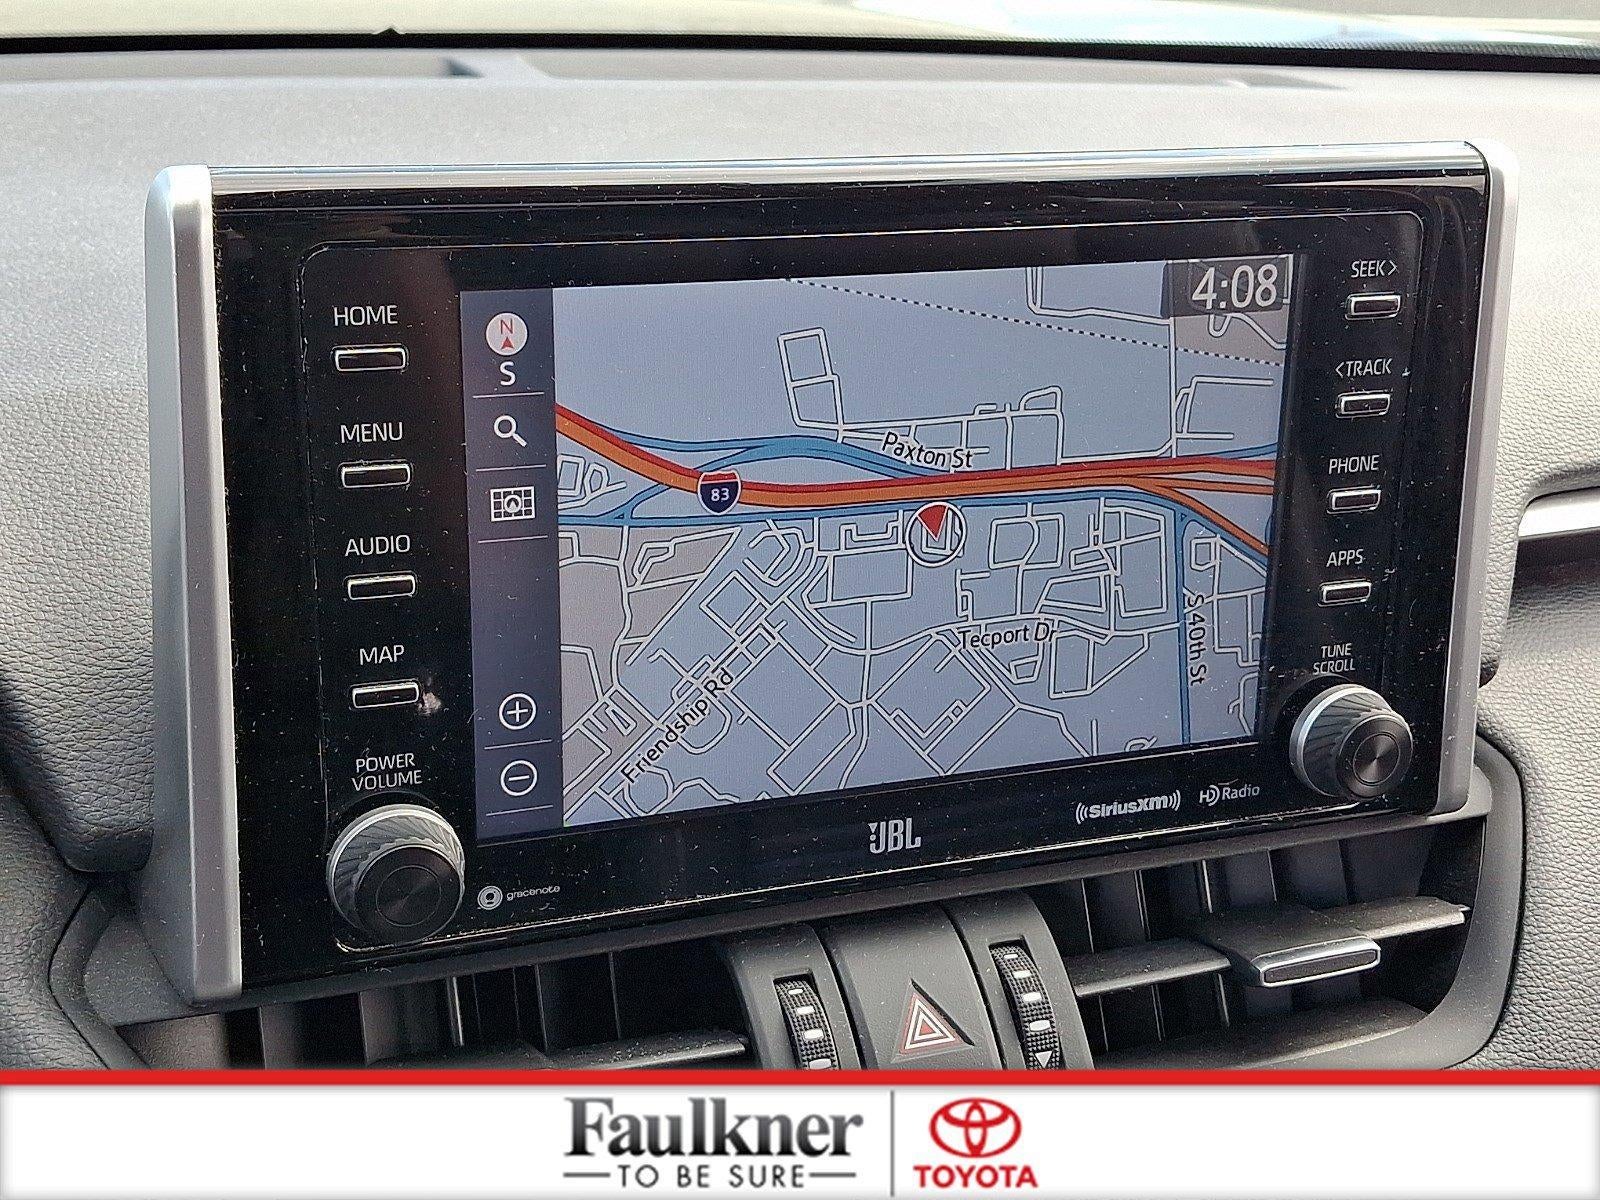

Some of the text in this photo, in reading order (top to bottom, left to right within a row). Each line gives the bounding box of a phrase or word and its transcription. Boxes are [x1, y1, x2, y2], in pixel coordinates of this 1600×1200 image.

[1191, 262, 1279, 311] 4:08
[333, 304, 399, 327] HOME
[500, 317, 514, 335] N
[499, 361, 517, 387] S
[340, 421, 404, 444] MENU
[882, 431, 974, 468] Paxton St
[1328, 454, 1380, 475] PHONE
[710, 487, 731, 501] 83
[344, 534, 412, 558] AUDIO
[1326, 548, 1364, 568] APPS
[957, 622, 1057, 649] Tecport Dr
[1187, 594, 1207, 687] S 40th St
[358, 644, 405, 666] MAP
[1320, 642, 1352, 659] TUNE
[1312, 658, 1356, 676] SCROLL
[620, 666, 734, 784] Friendship Rd
[355, 752, 416, 773] POWER
[351, 769, 423, 793] VOLUME
[1222, 783, 1261, 801] Radio
[868, 817, 922, 855] JBL
[506, 885, 561, 902] gracenote
